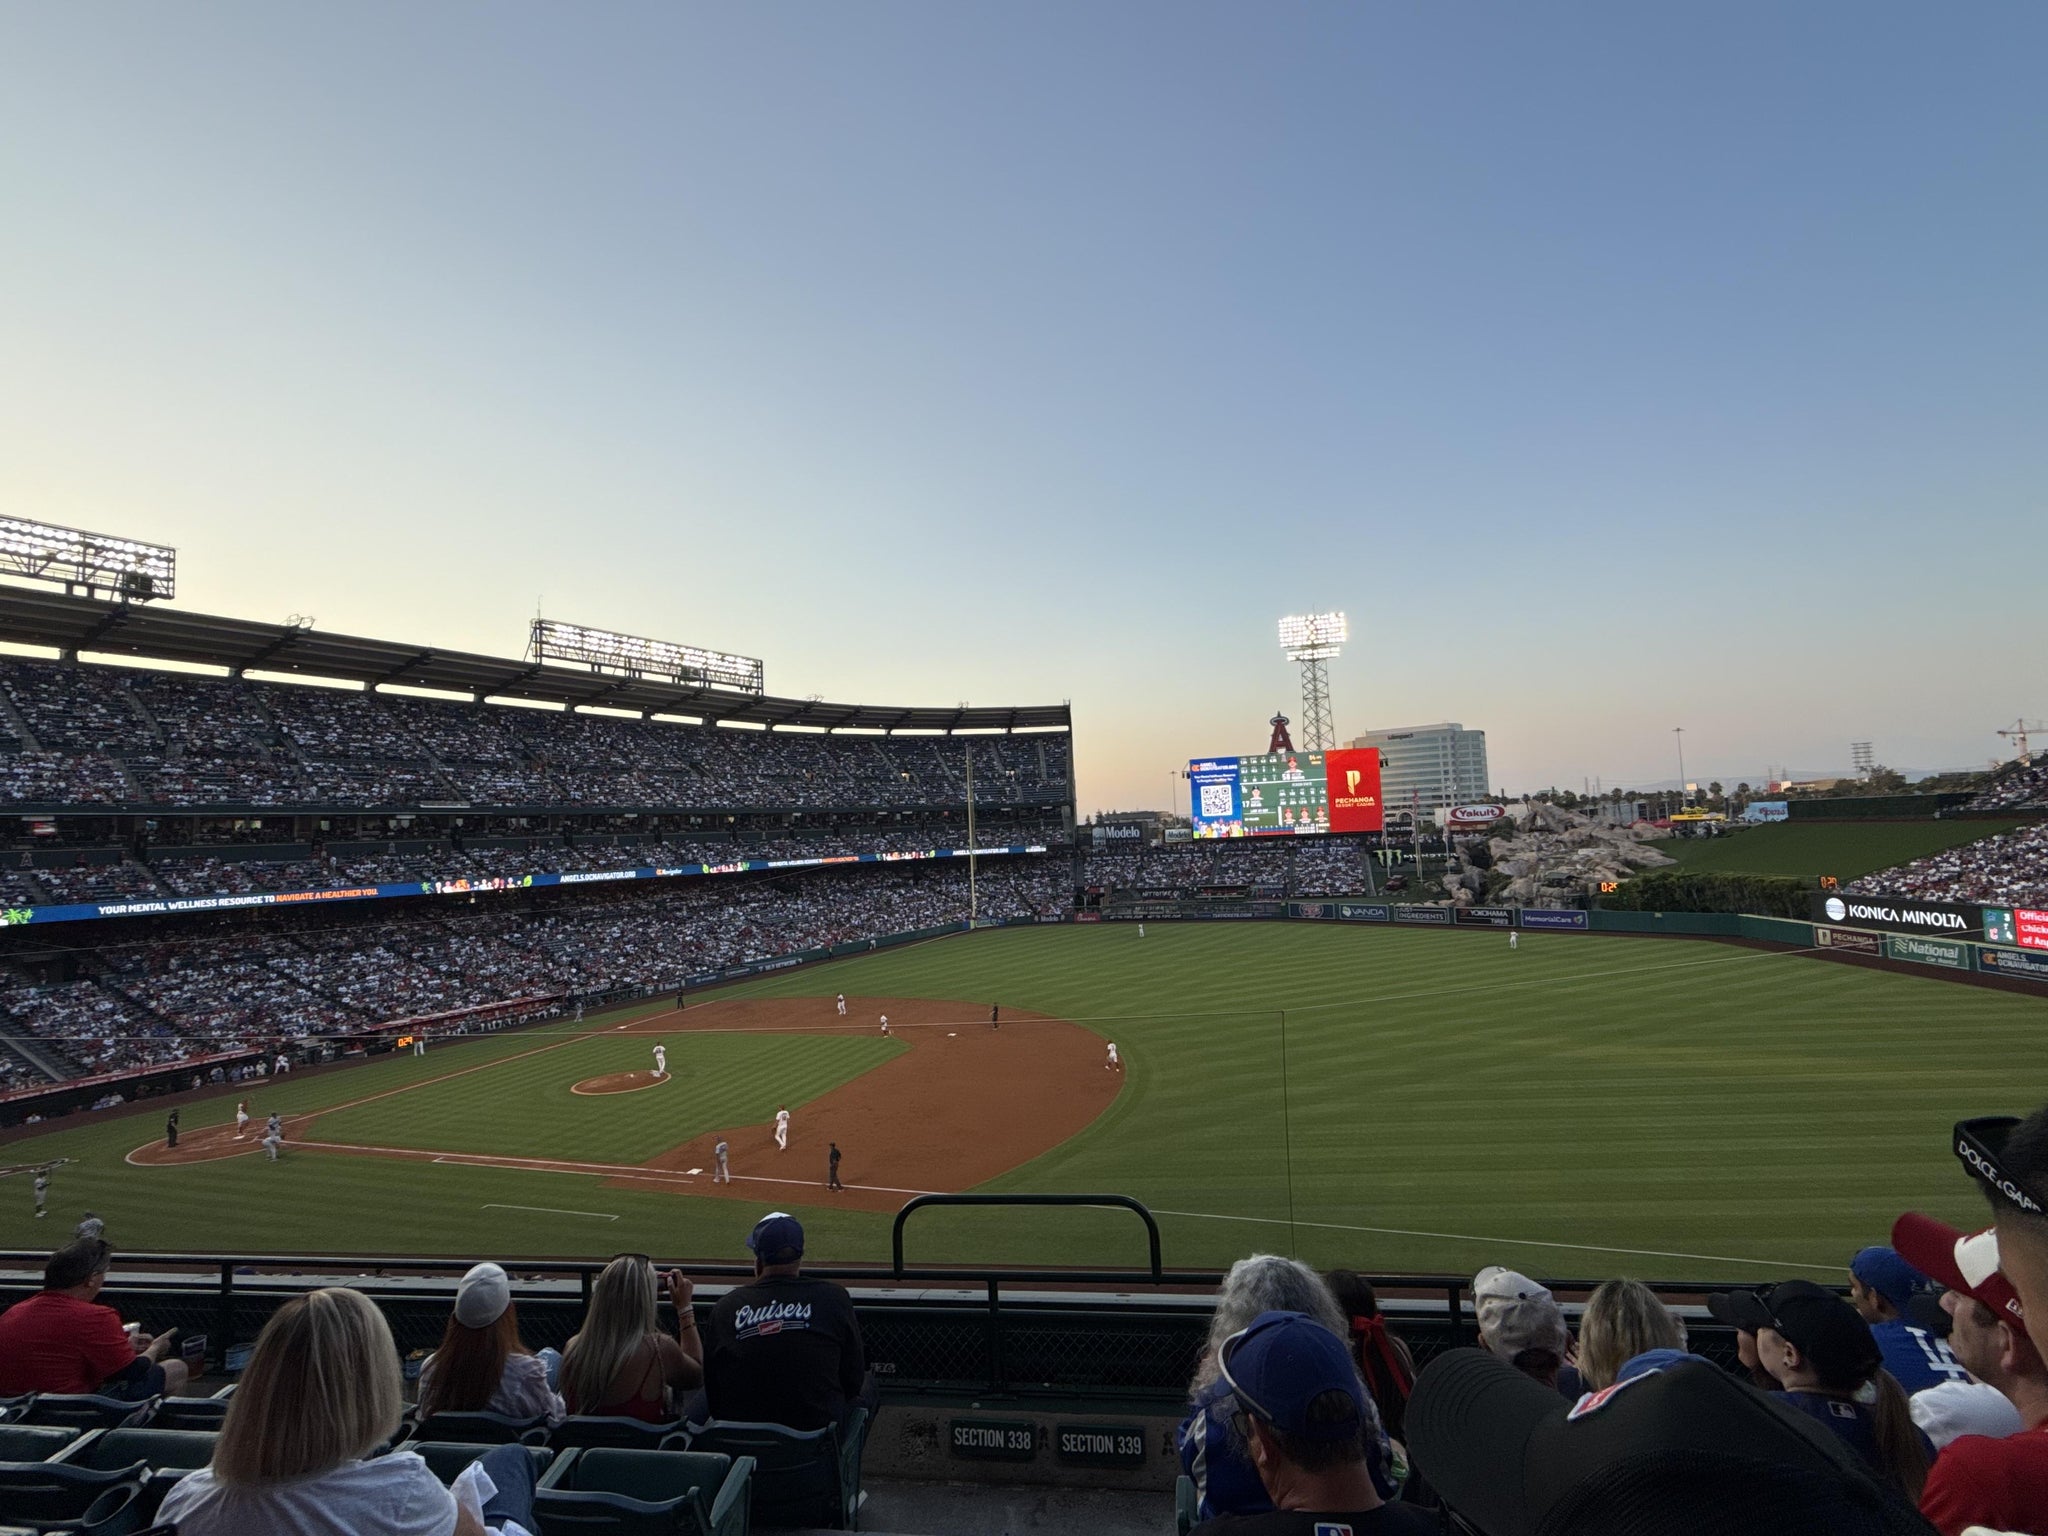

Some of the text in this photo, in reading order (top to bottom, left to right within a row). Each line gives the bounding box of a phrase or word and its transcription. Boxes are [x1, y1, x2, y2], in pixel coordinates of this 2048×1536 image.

[1460, 808, 1497, 818] Yakult
[1106, 826, 1140, 839] Modelo
[1168, 830, 1190, 838] Modelo
[560, 870, 636, 883] ANGELS.OCNAVIGATOR.ORG
[98, 905, 126, 915] YOUR
[128, 902, 166, 912] MENTAL
[168, 899, 217, 910] WELLNESS
[218, 896, 263, 906] RESOURCE
[264, 895, 275, 903] TO
[276, 892, 314, 902] NAVIGATE
[322, 890, 361, 898] HEALTHIER
[1400, 912, 1443, 920] INGREDIENTS
[1848, 904, 1967, 929] KONICA MINOLTA
[1832, 933, 1874, 944] PECHANGA
[1908, 942, 1958, 958] National
[1958, 1140, 1998, 1183] DOLCE
[735, 1300, 812, 1329] Cruisers
[954, 1427, 1031, 1450] SECTION 338
[1062, 1434, 1142, 1455] SECTION 339
